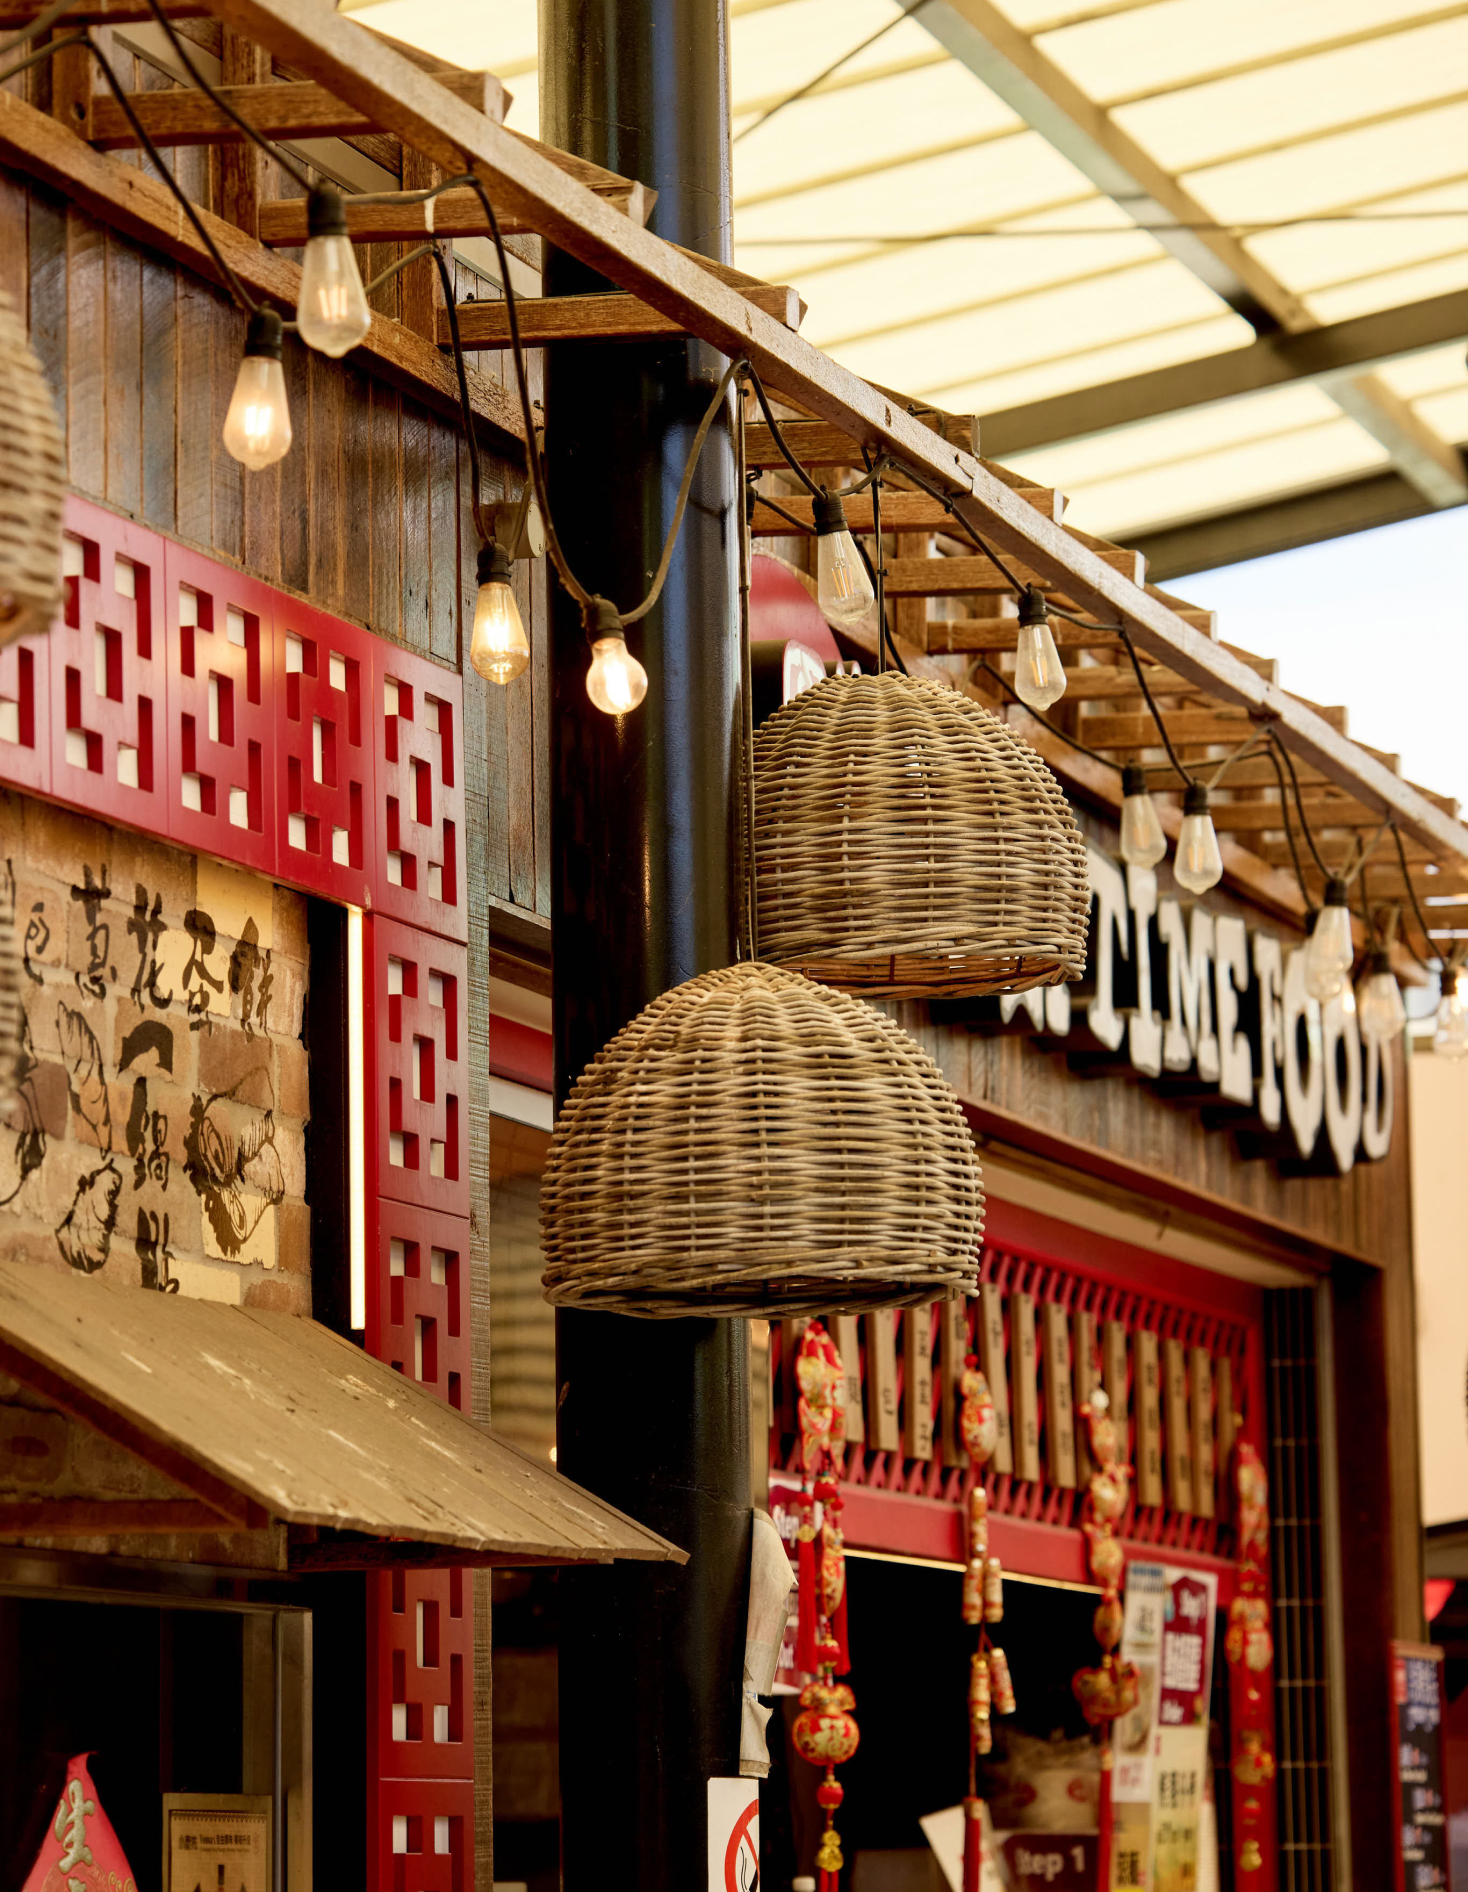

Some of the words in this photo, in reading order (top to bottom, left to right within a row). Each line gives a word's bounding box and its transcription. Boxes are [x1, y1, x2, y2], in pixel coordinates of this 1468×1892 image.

[1087, 848, 1254, 1106] TIME
[1253, 931, 1393, 1173] FOOD
[1015, 1847, 1064, 1882] Step
[1070, 1845, 1086, 1872] 1
